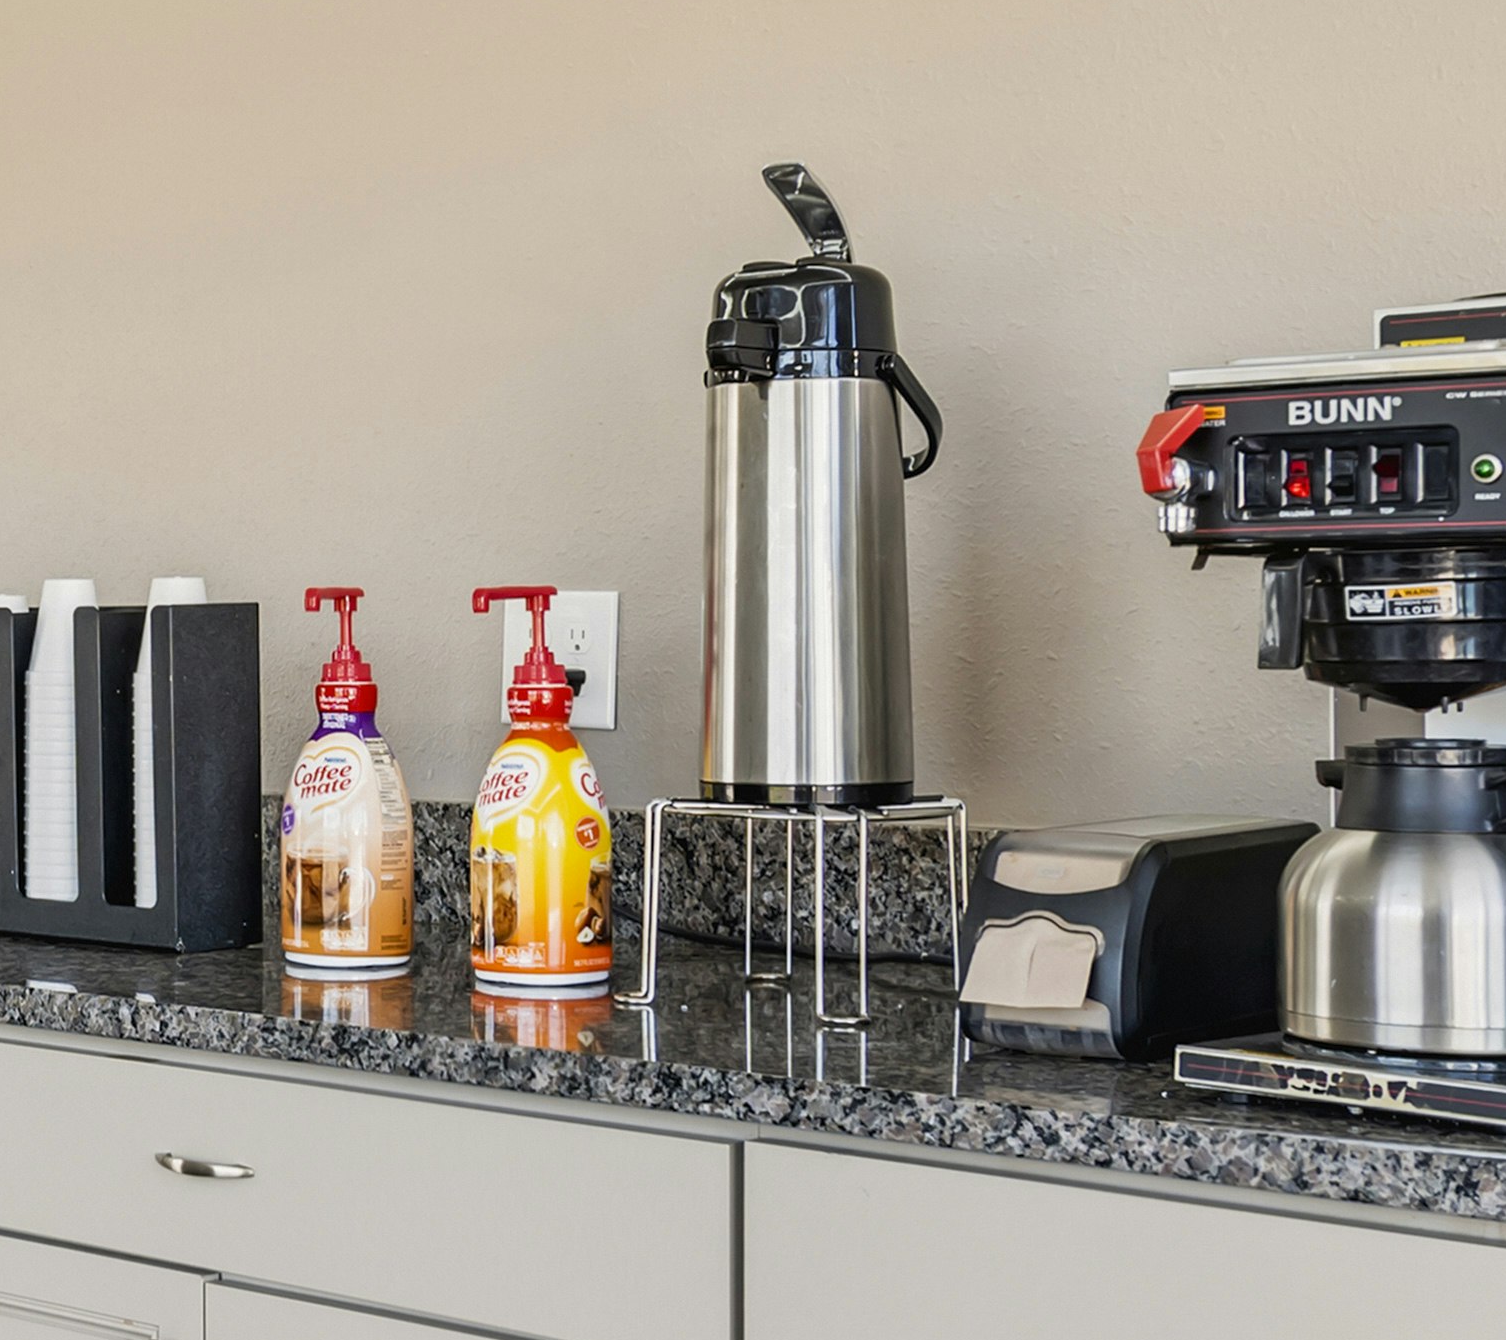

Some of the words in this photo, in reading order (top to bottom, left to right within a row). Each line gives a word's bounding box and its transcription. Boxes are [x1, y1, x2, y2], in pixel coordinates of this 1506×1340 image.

[294, 763, 353, 788] Coffee
[481, 770, 529, 793] offee
[300, 778, 353, 800] mate
[479, 785, 527, 808] mate
